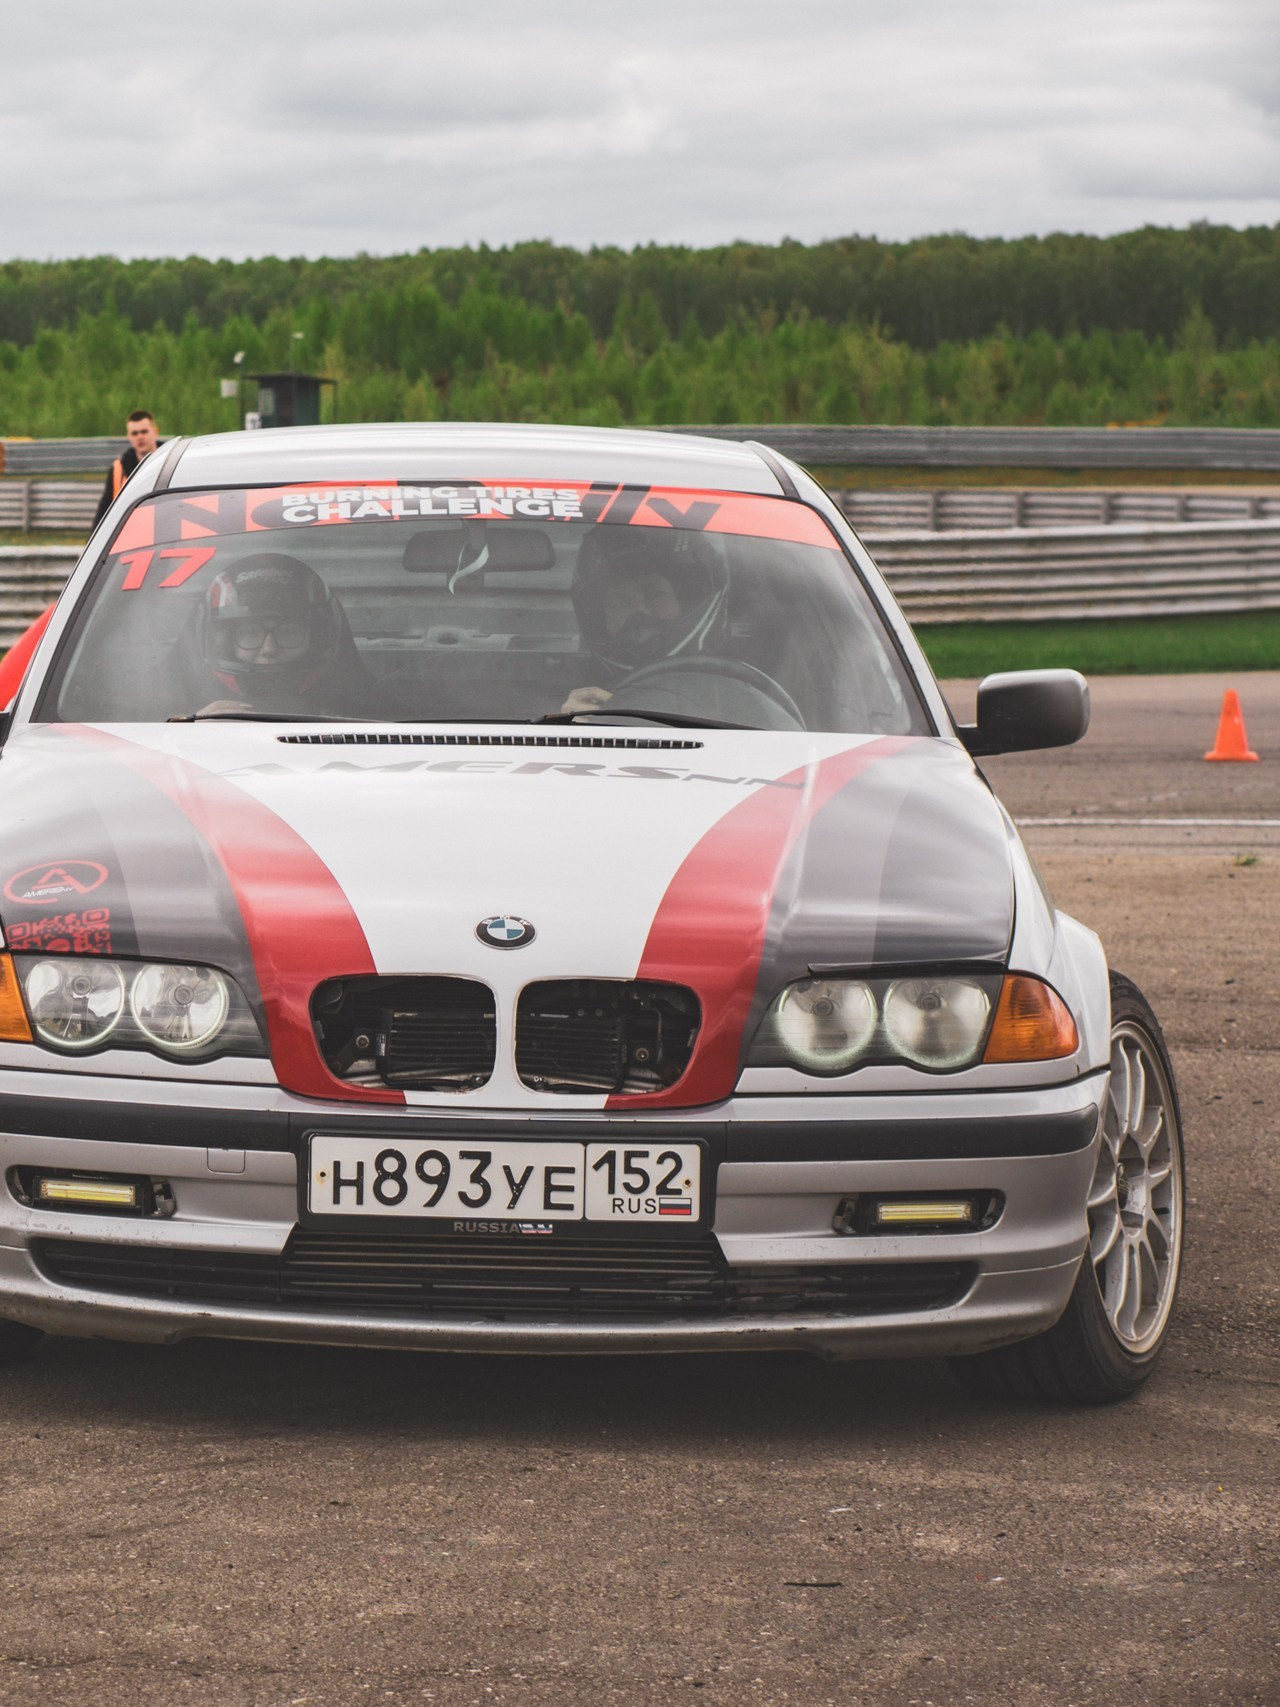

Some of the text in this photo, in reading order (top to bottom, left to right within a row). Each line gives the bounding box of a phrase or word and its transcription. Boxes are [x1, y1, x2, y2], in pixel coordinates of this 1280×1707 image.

[282, 486, 580, 507] BURNING TIRES
[282, 498, 583, 523] CHALLENGE
[120, 546, 217, 592] 17
[591, 1150, 684, 1197] 152
[611, 1197, 658, 1215] RUS
[453, 1221, 521, 1235] RUSSIA
